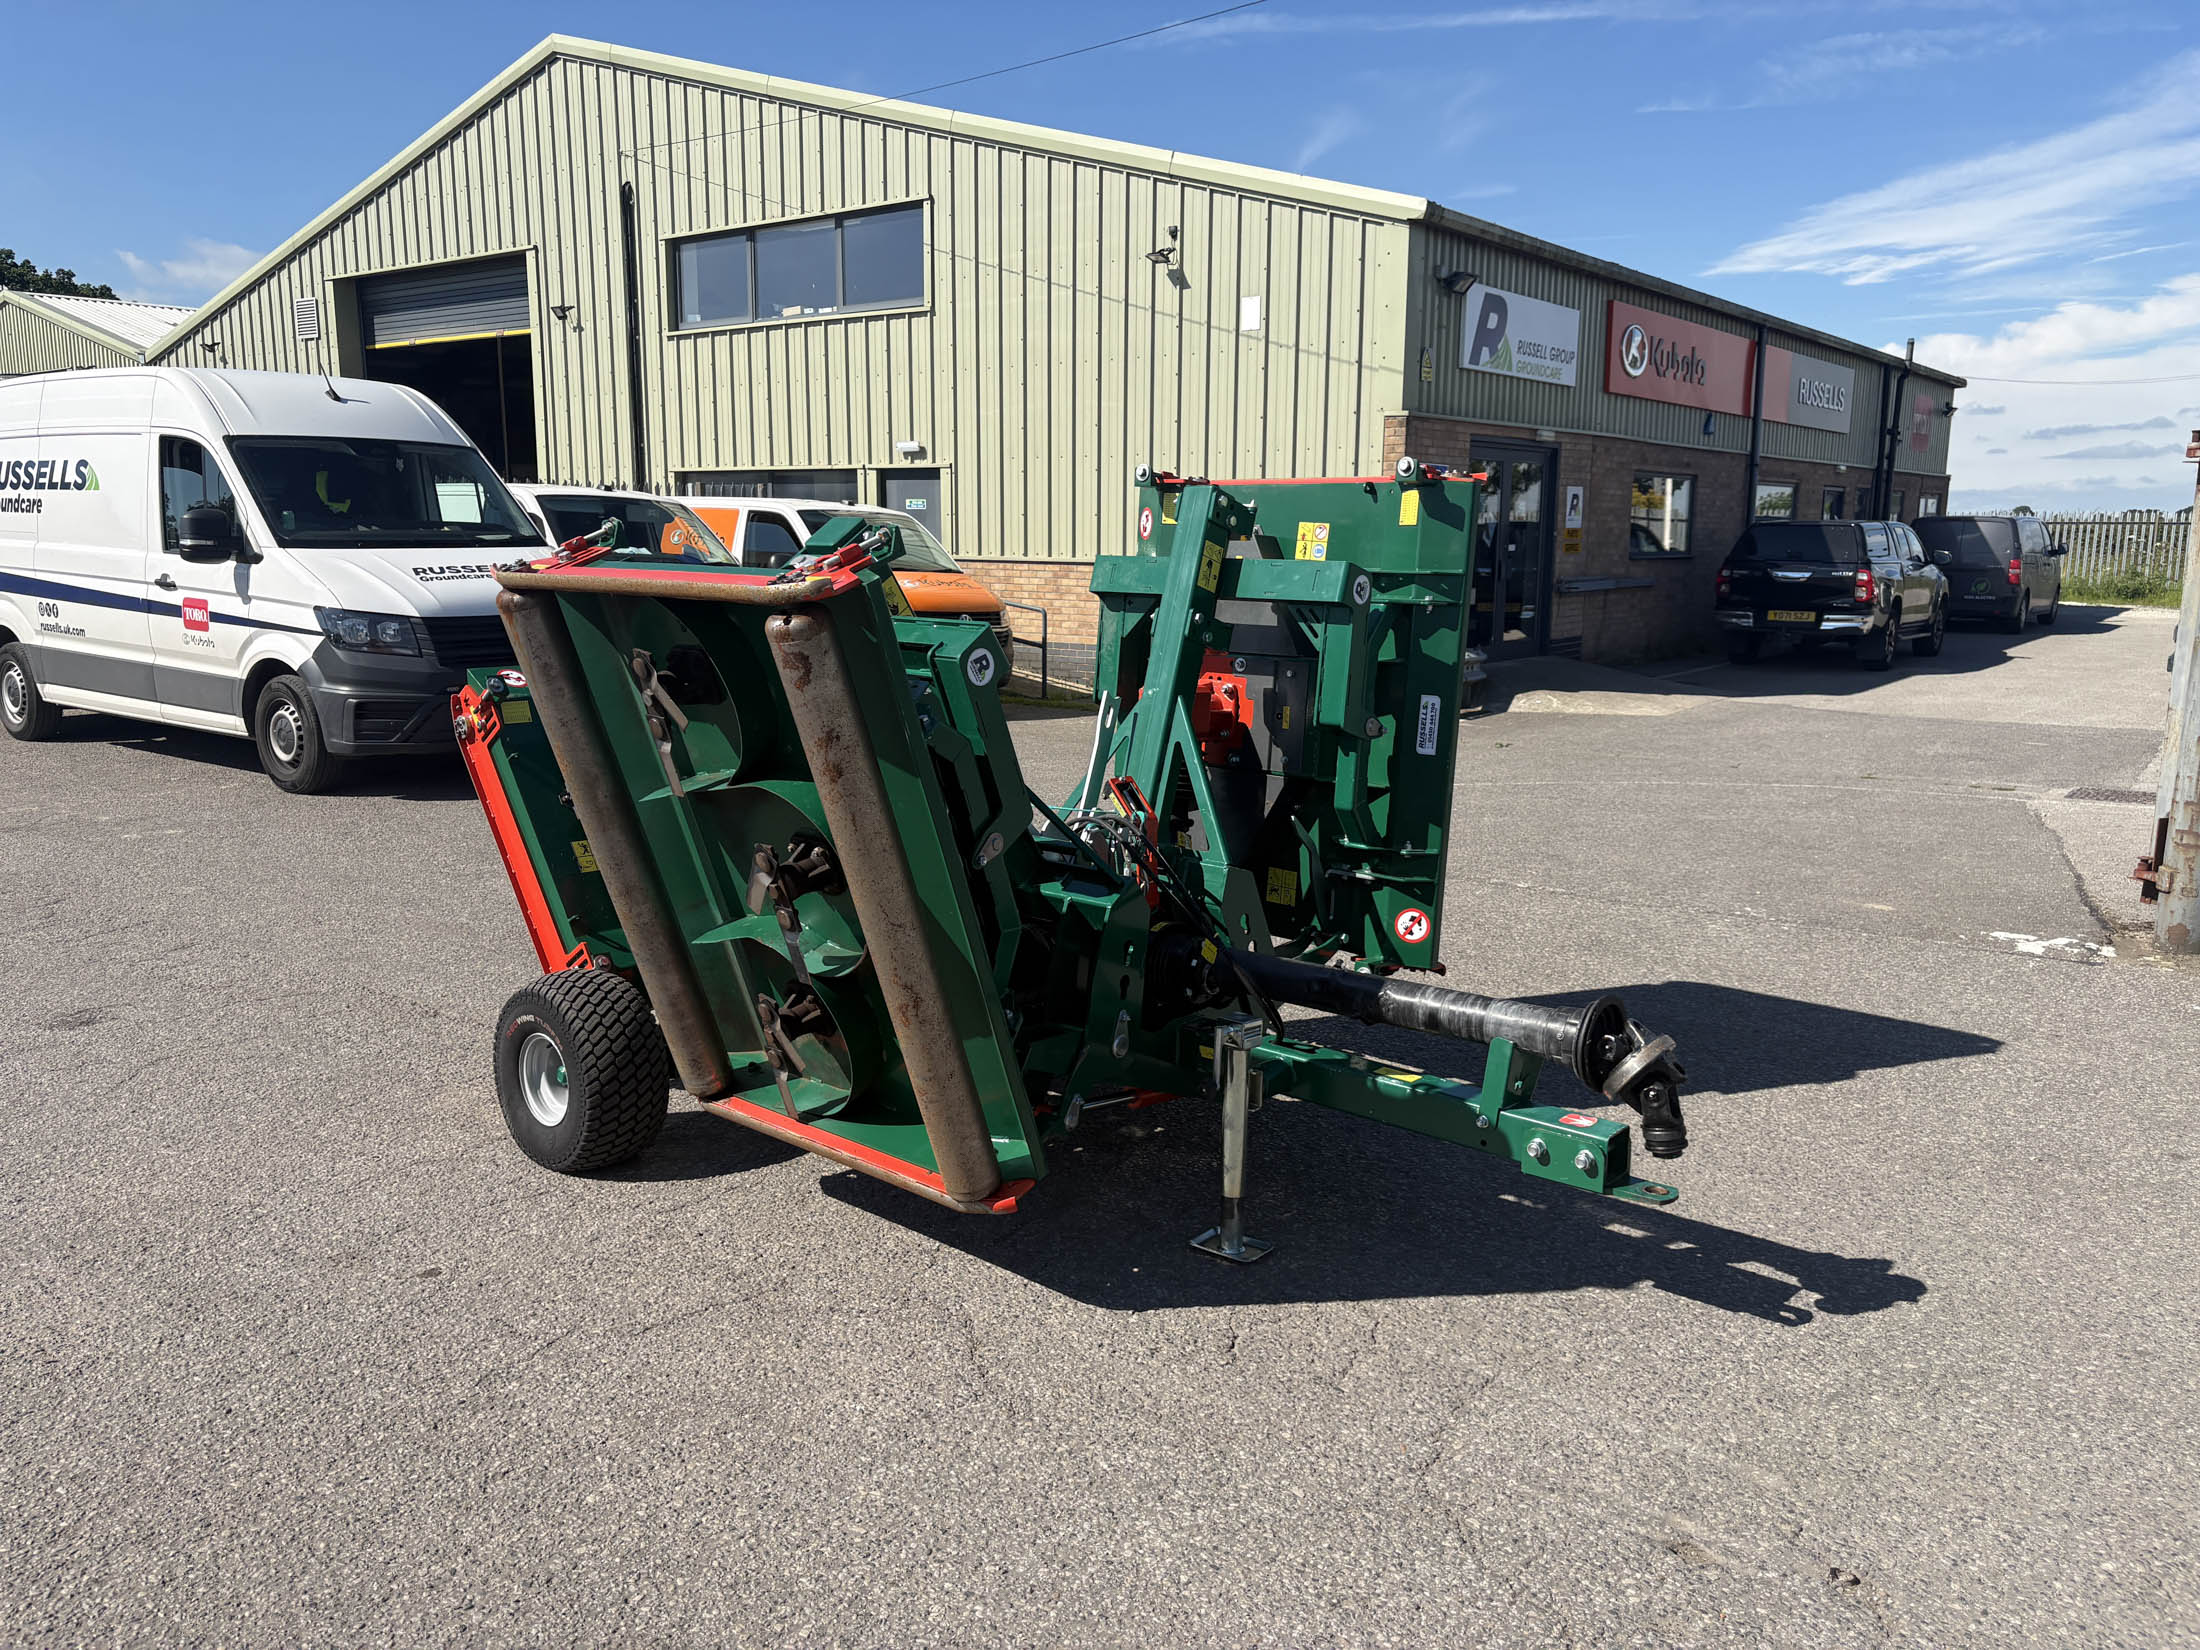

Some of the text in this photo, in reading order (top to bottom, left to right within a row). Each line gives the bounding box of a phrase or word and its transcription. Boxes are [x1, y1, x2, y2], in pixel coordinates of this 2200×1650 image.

[1516, 339, 1576, 365] RUSSELL GROUP
[1648, 335, 1707, 387] Kubota
[1515, 359, 1564, 381] GROUNDCARE
[1798, 377, 1846, 412] RUSSELLS
[0, 458, 89, 491] USSELLS
[0, 493, 43, 514] undcare
[411, 564, 491, 577] RUSSE
[419, 573, 494, 582] Groundcare
[40, 621, 86, 638] russells.uk.com
[1418, 703, 1428, 749] RUSSELLS
